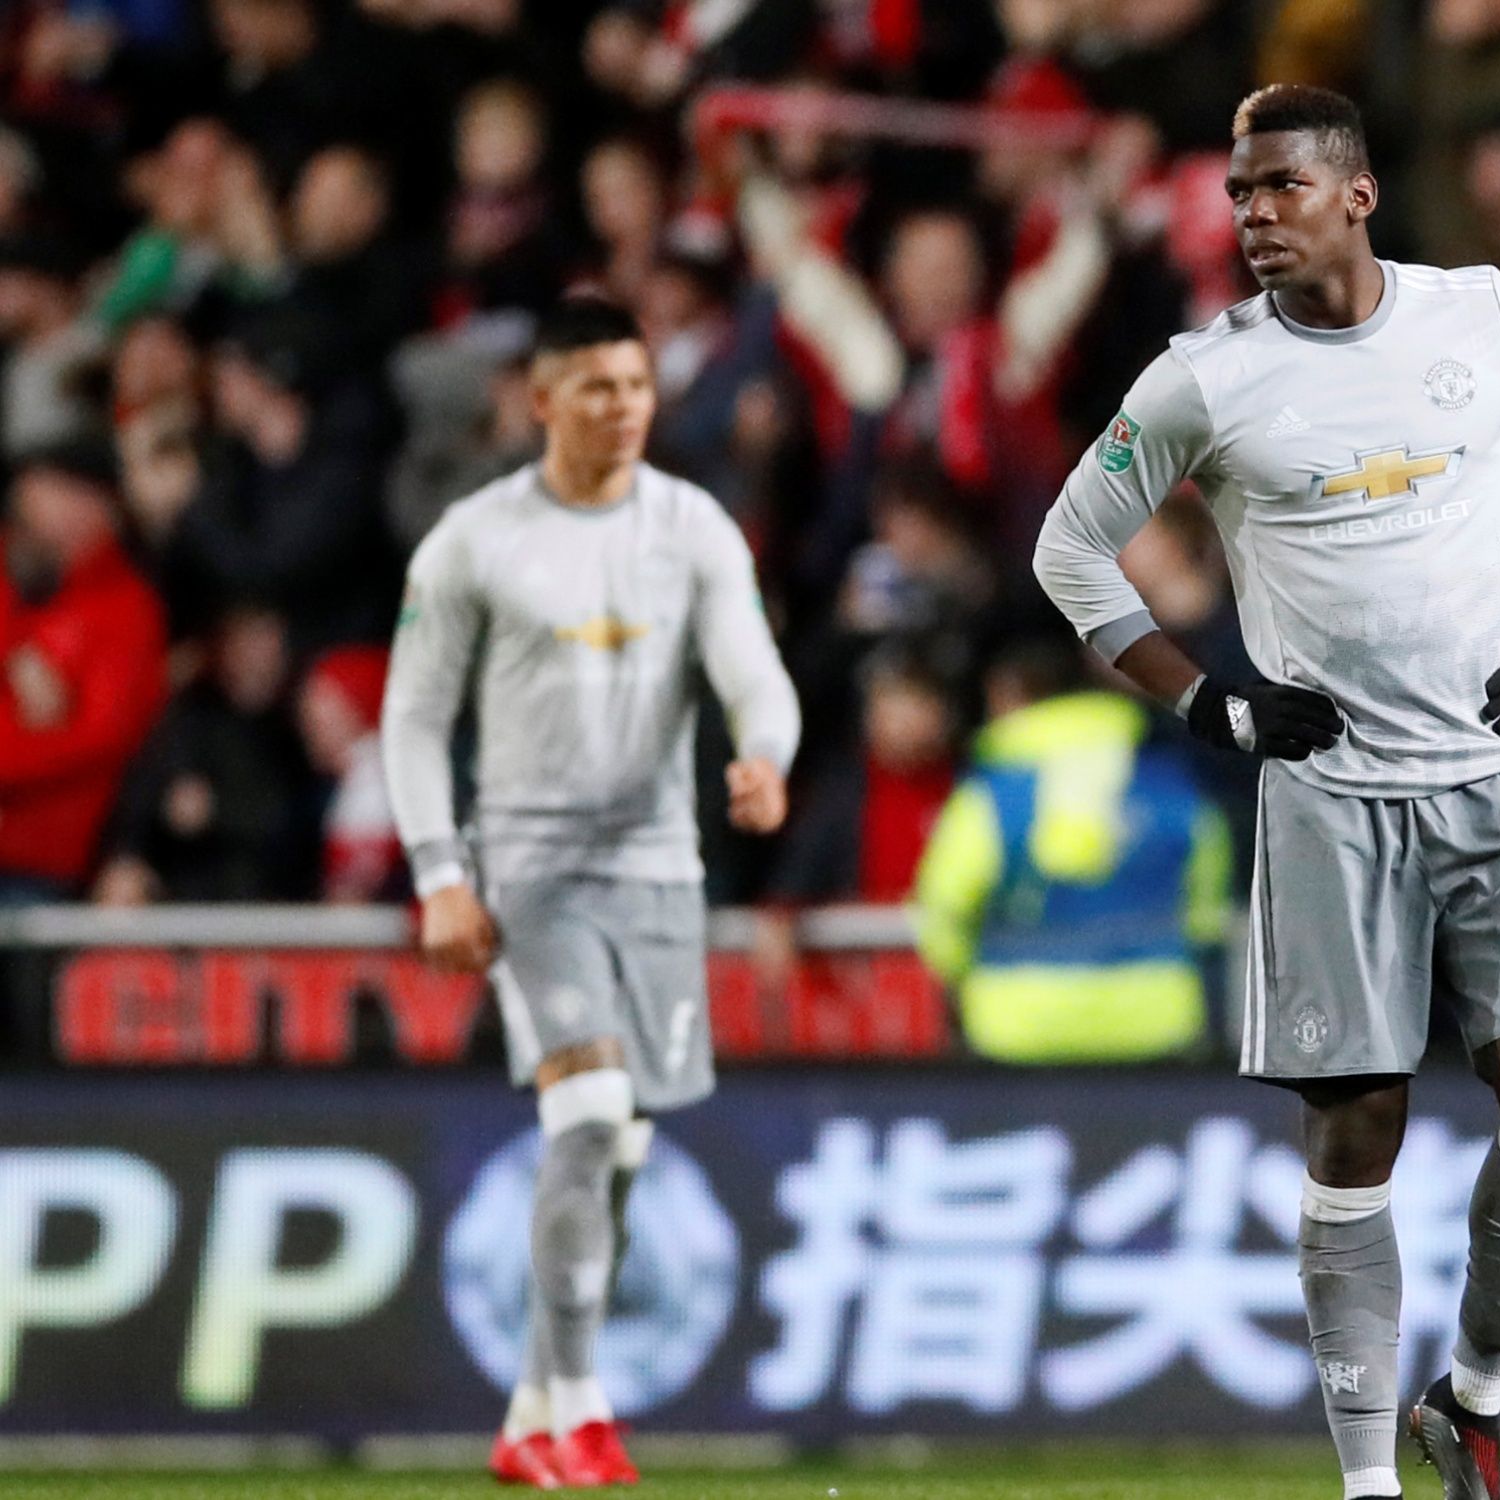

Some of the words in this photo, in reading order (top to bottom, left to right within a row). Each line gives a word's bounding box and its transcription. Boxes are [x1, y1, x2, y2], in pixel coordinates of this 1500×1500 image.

[1438, 396, 1471, 410] UNITED
[1265, 420, 1312, 440] adidas
[1308, 499, 1472, 542] CHEVROLET
[57, 948, 485, 1063] CITY
